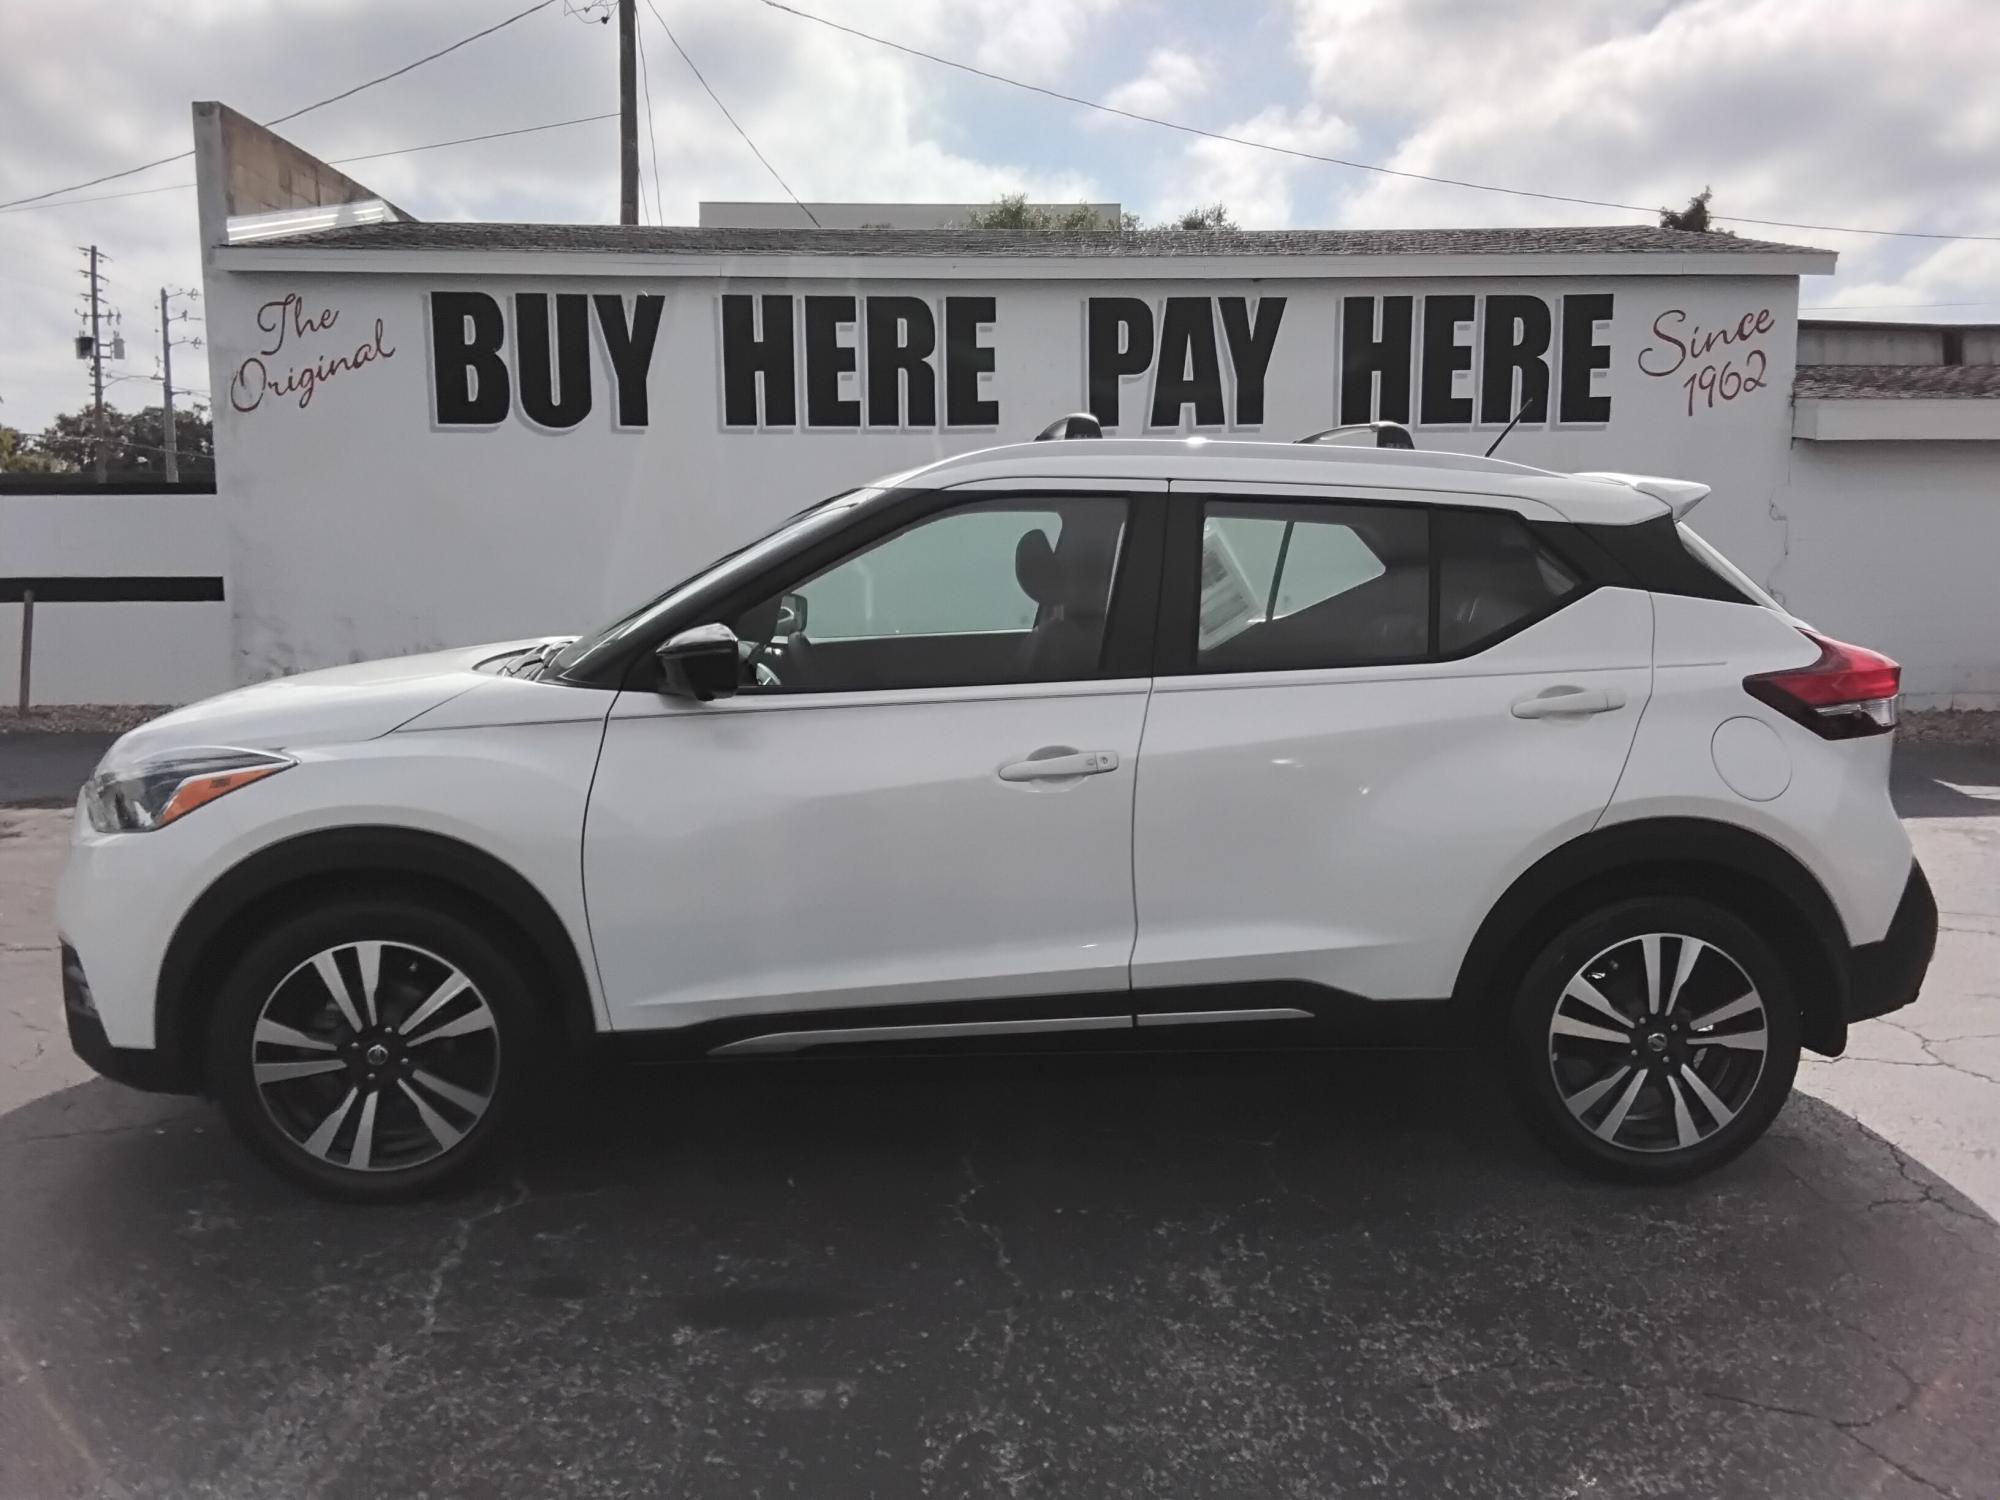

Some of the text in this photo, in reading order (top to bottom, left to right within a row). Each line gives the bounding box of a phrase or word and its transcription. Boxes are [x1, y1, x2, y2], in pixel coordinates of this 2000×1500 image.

[257, 293, 340, 356] The
[1638, 309, 1775, 377] Since
[230, 318, 396, 413] Original
[430, 291, 1614, 429] BUY HERE PAY HERE
[1683, 349, 1767, 417] 1962
